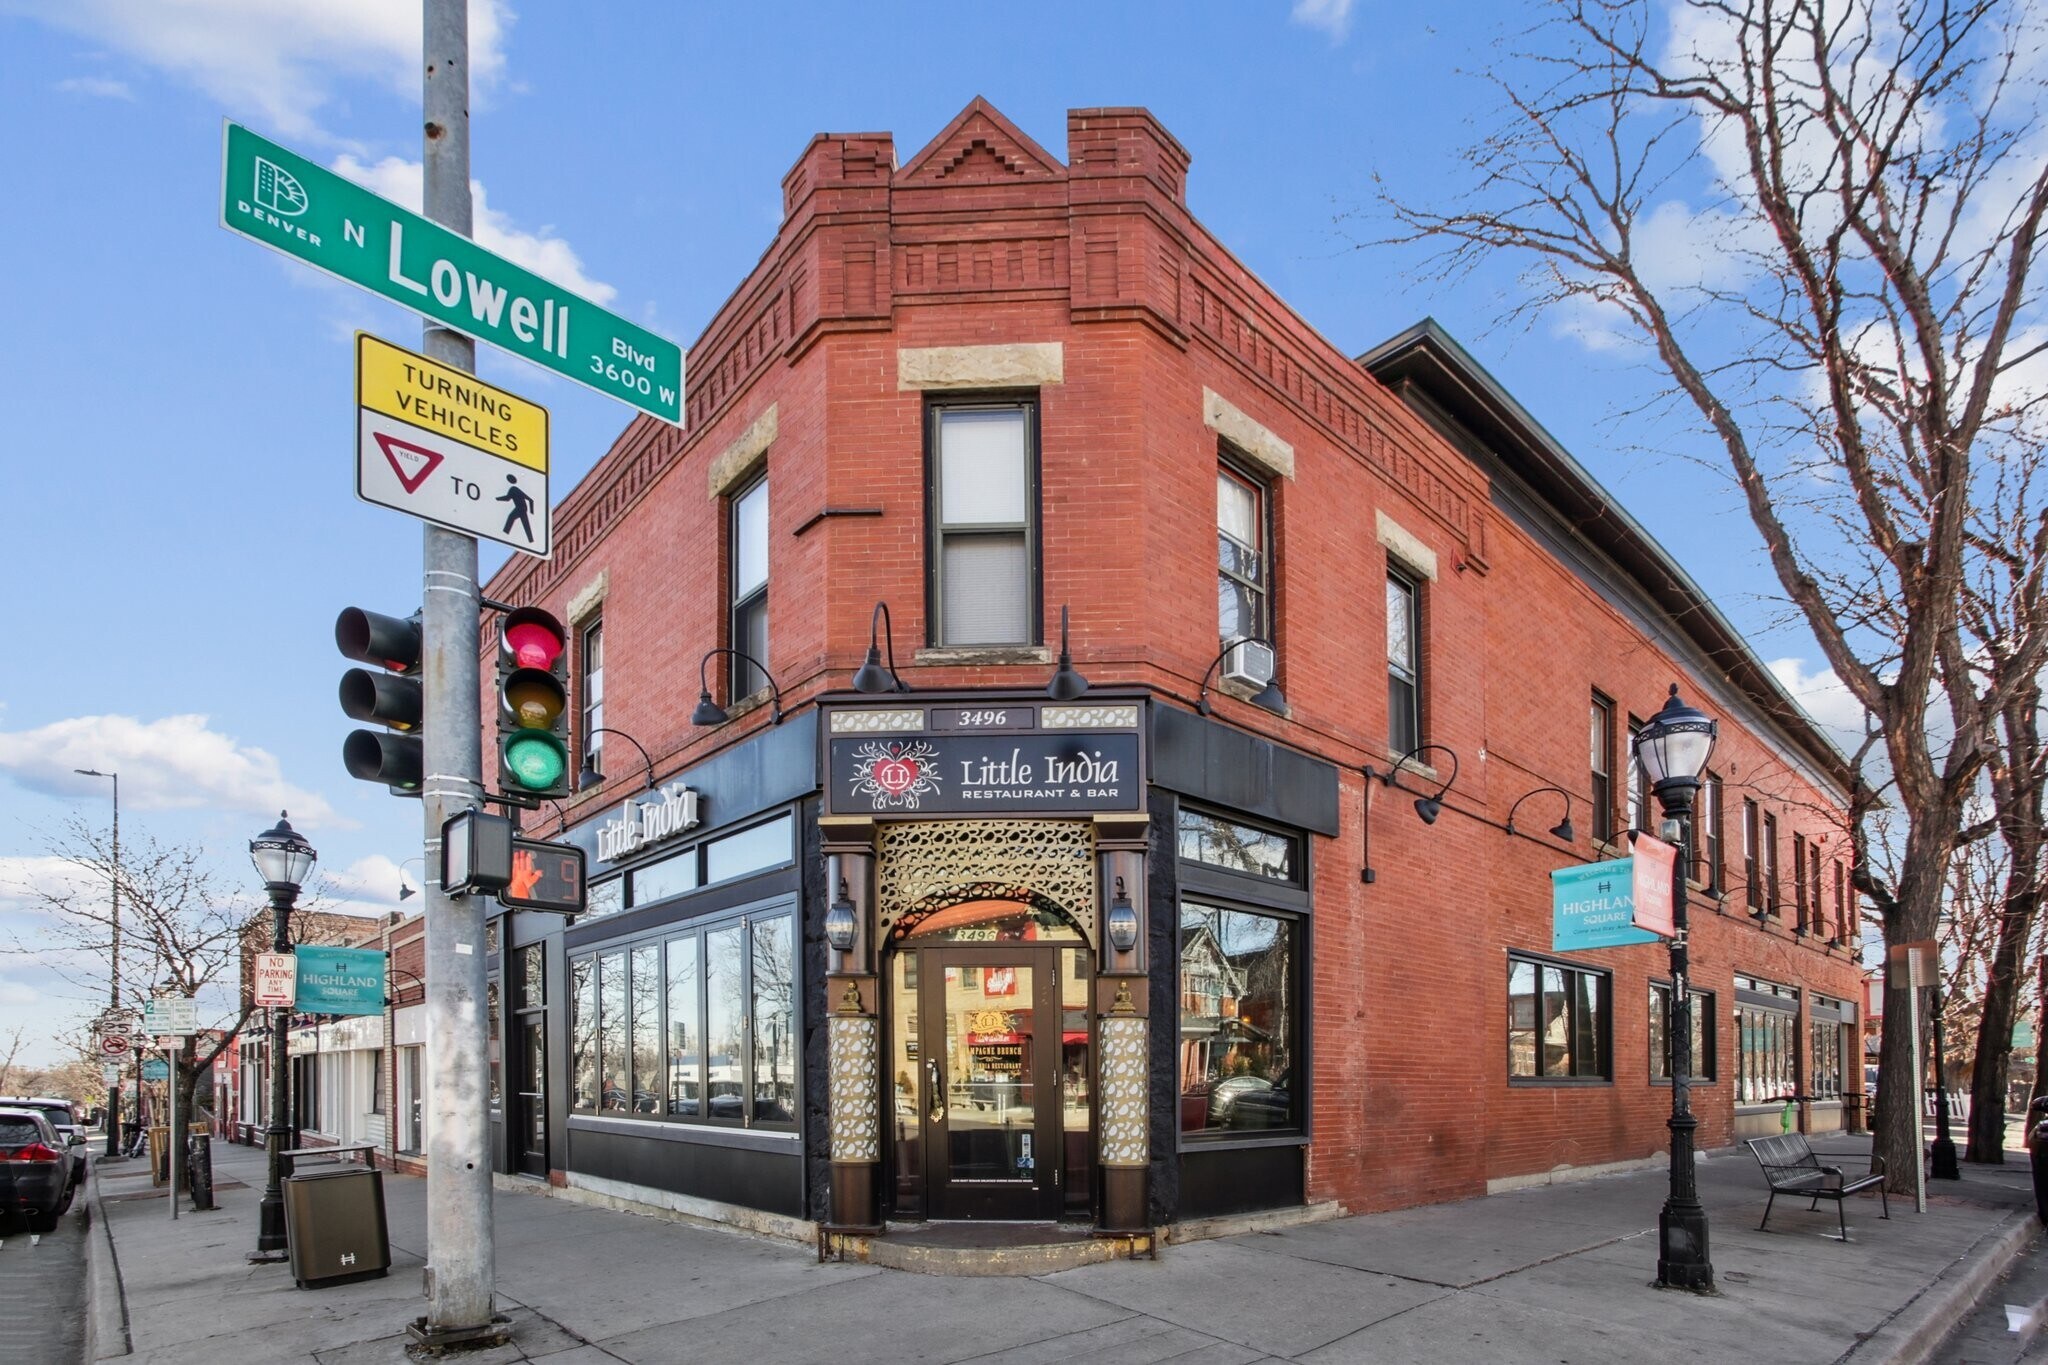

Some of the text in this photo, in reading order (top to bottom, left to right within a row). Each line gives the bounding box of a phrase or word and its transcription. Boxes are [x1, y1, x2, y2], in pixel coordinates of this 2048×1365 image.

[238, 200, 322, 248] DENVER
[344, 219, 569, 359] N Lowell
[611, 337, 656, 373] Blvd
[589, 355, 675, 407] 3600 W
[402, 363, 513, 422] TURNING
[396, 390, 519, 452] VEHICLES
[399, 450, 420, 464] YIELD
[450, 475, 481, 502] TO
[958, 710, 1007, 726] 3496
[961, 748, 1119, 785] Little India
[884, 769, 905, 784] LI
[962, 788, 1119, 799] RESTAURANT & BAR
[597, 782, 699, 863] Little India
[1562, 895, 1636, 916] HIGHLAN
[1583, 911, 1628, 926] SQUARE
[959, 930, 996, 941] 3496
[269, 957, 285, 968] NO
[260, 968, 293, 980] PARKING
[303, 974, 377, 988] HIGHLAND
[321, 988, 359, 997] SQUARE
[146, 1001, 154, 1013] 2
[997, 1046, 1022, 1055] BRUNCH
[991, 1062, 1022, 1070] RESTAURANT
